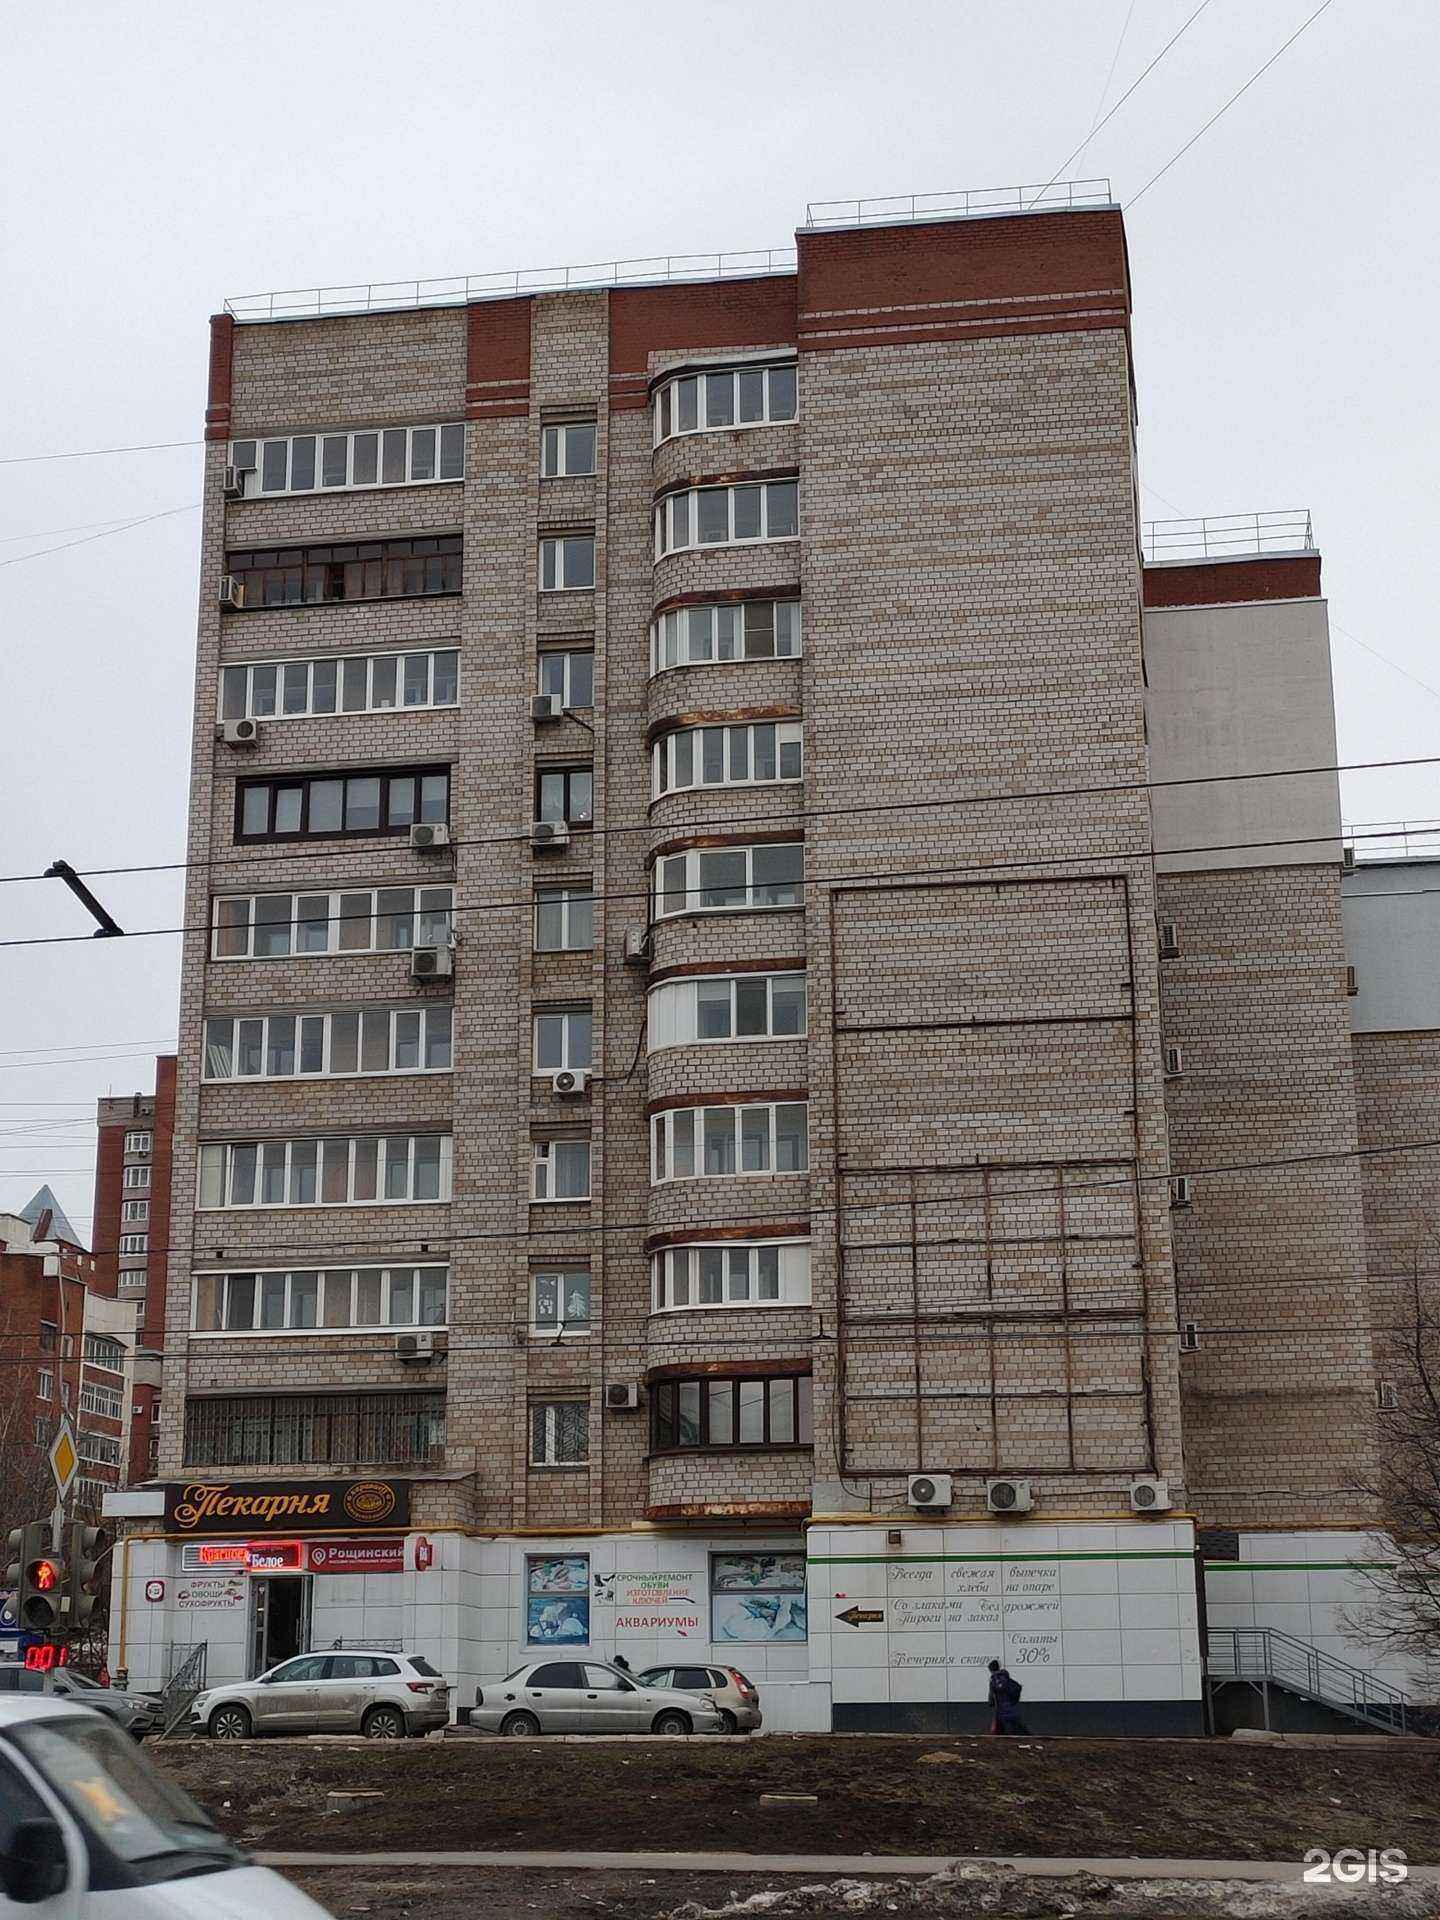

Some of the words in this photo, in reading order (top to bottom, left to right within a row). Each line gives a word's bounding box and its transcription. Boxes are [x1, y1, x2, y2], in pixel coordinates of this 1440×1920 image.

[174, 1484, 331, 1528] Пекарня
[251, 1554, 284, 1568] Белое
[950, 1567, 995, 1579] свежая
[1009, 1566, 1057, 1578] выпечка
[191, 1590, 223, 1598] ОВОЩИ
[616, 1617, 699, 1627] АКВАРИУМЫ
[1016, 1648, 1050, 1664] 30%
